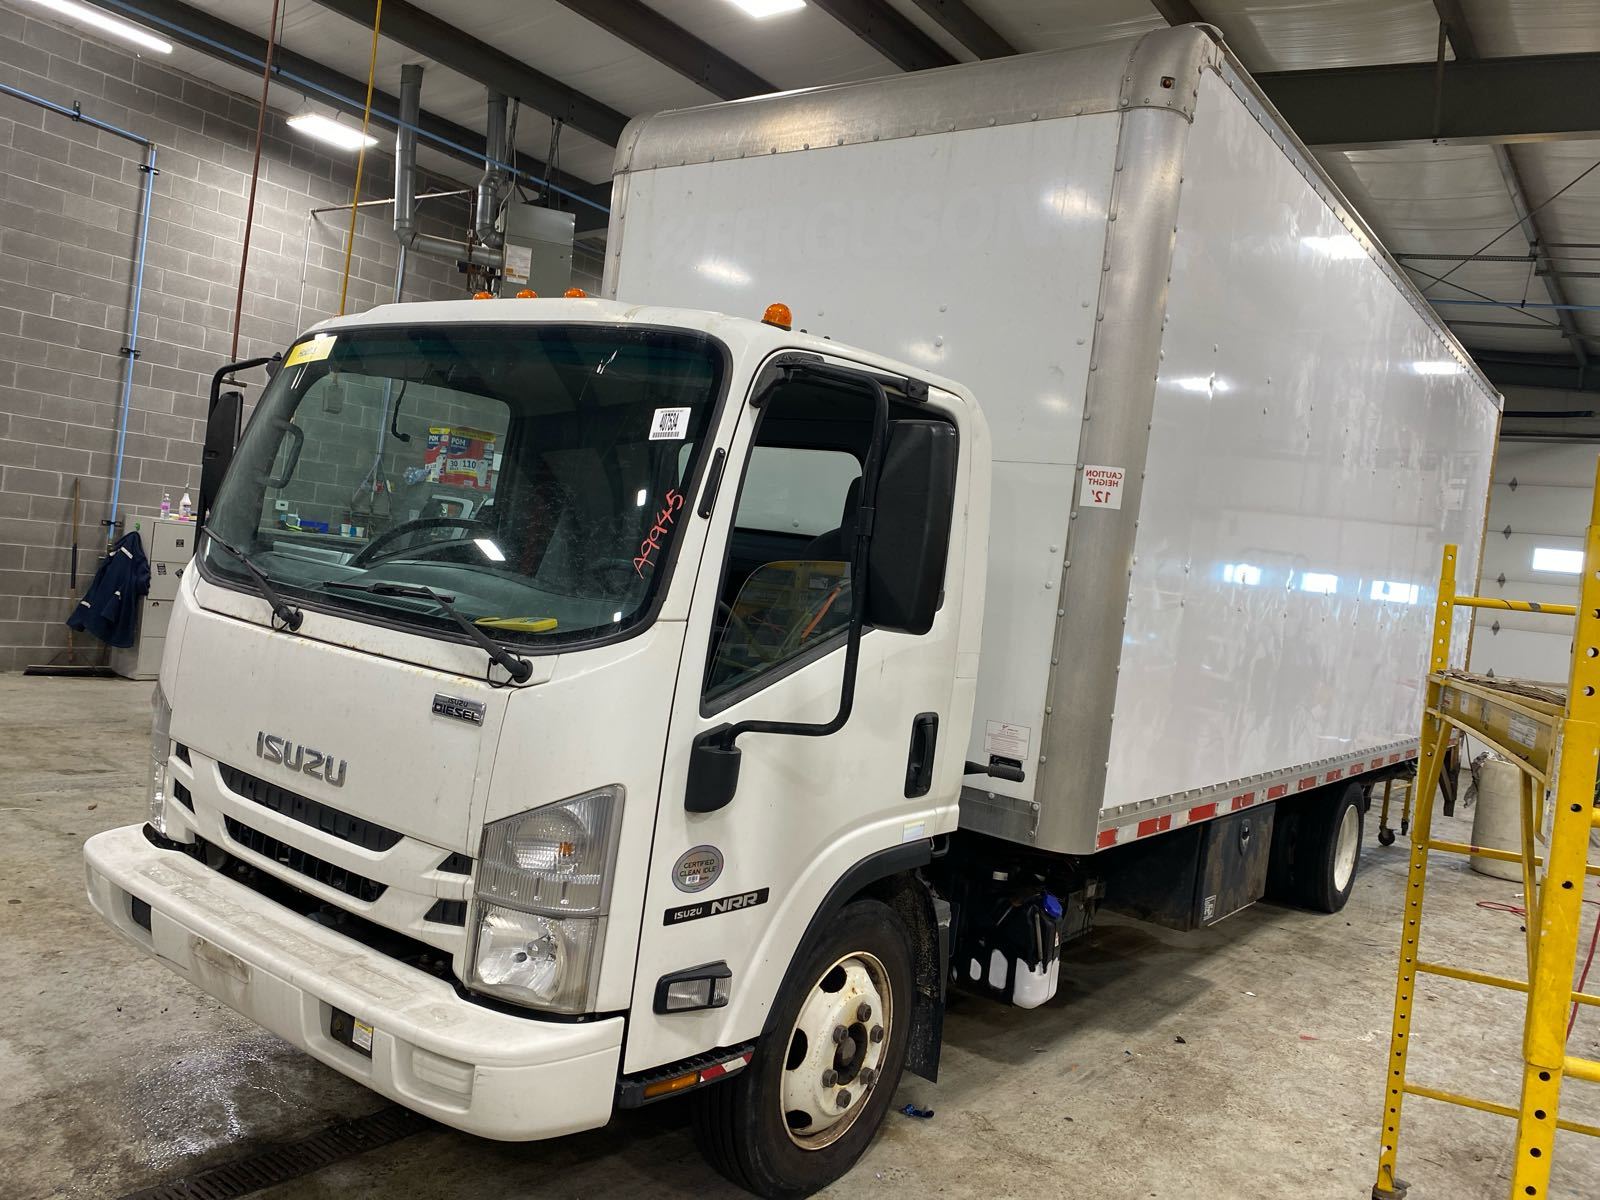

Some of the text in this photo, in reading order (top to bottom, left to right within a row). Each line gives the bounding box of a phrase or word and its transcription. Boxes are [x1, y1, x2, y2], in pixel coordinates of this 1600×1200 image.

[452, 437, 466, 446] POM
[462, 460, 476, 468] 110
[633, 489, 684, 579] A9945
[448, 698, 469, 708] ISUZU
[434, 702, 481, 722] DIESEL
[256, 731, 348, 788] ISUZU
[684, 858, 714, 869] CERTIFIED
[680, 866, 717, 877] CLEAN IDLE
[674, 892, 759, 920] ISUZU NRR
